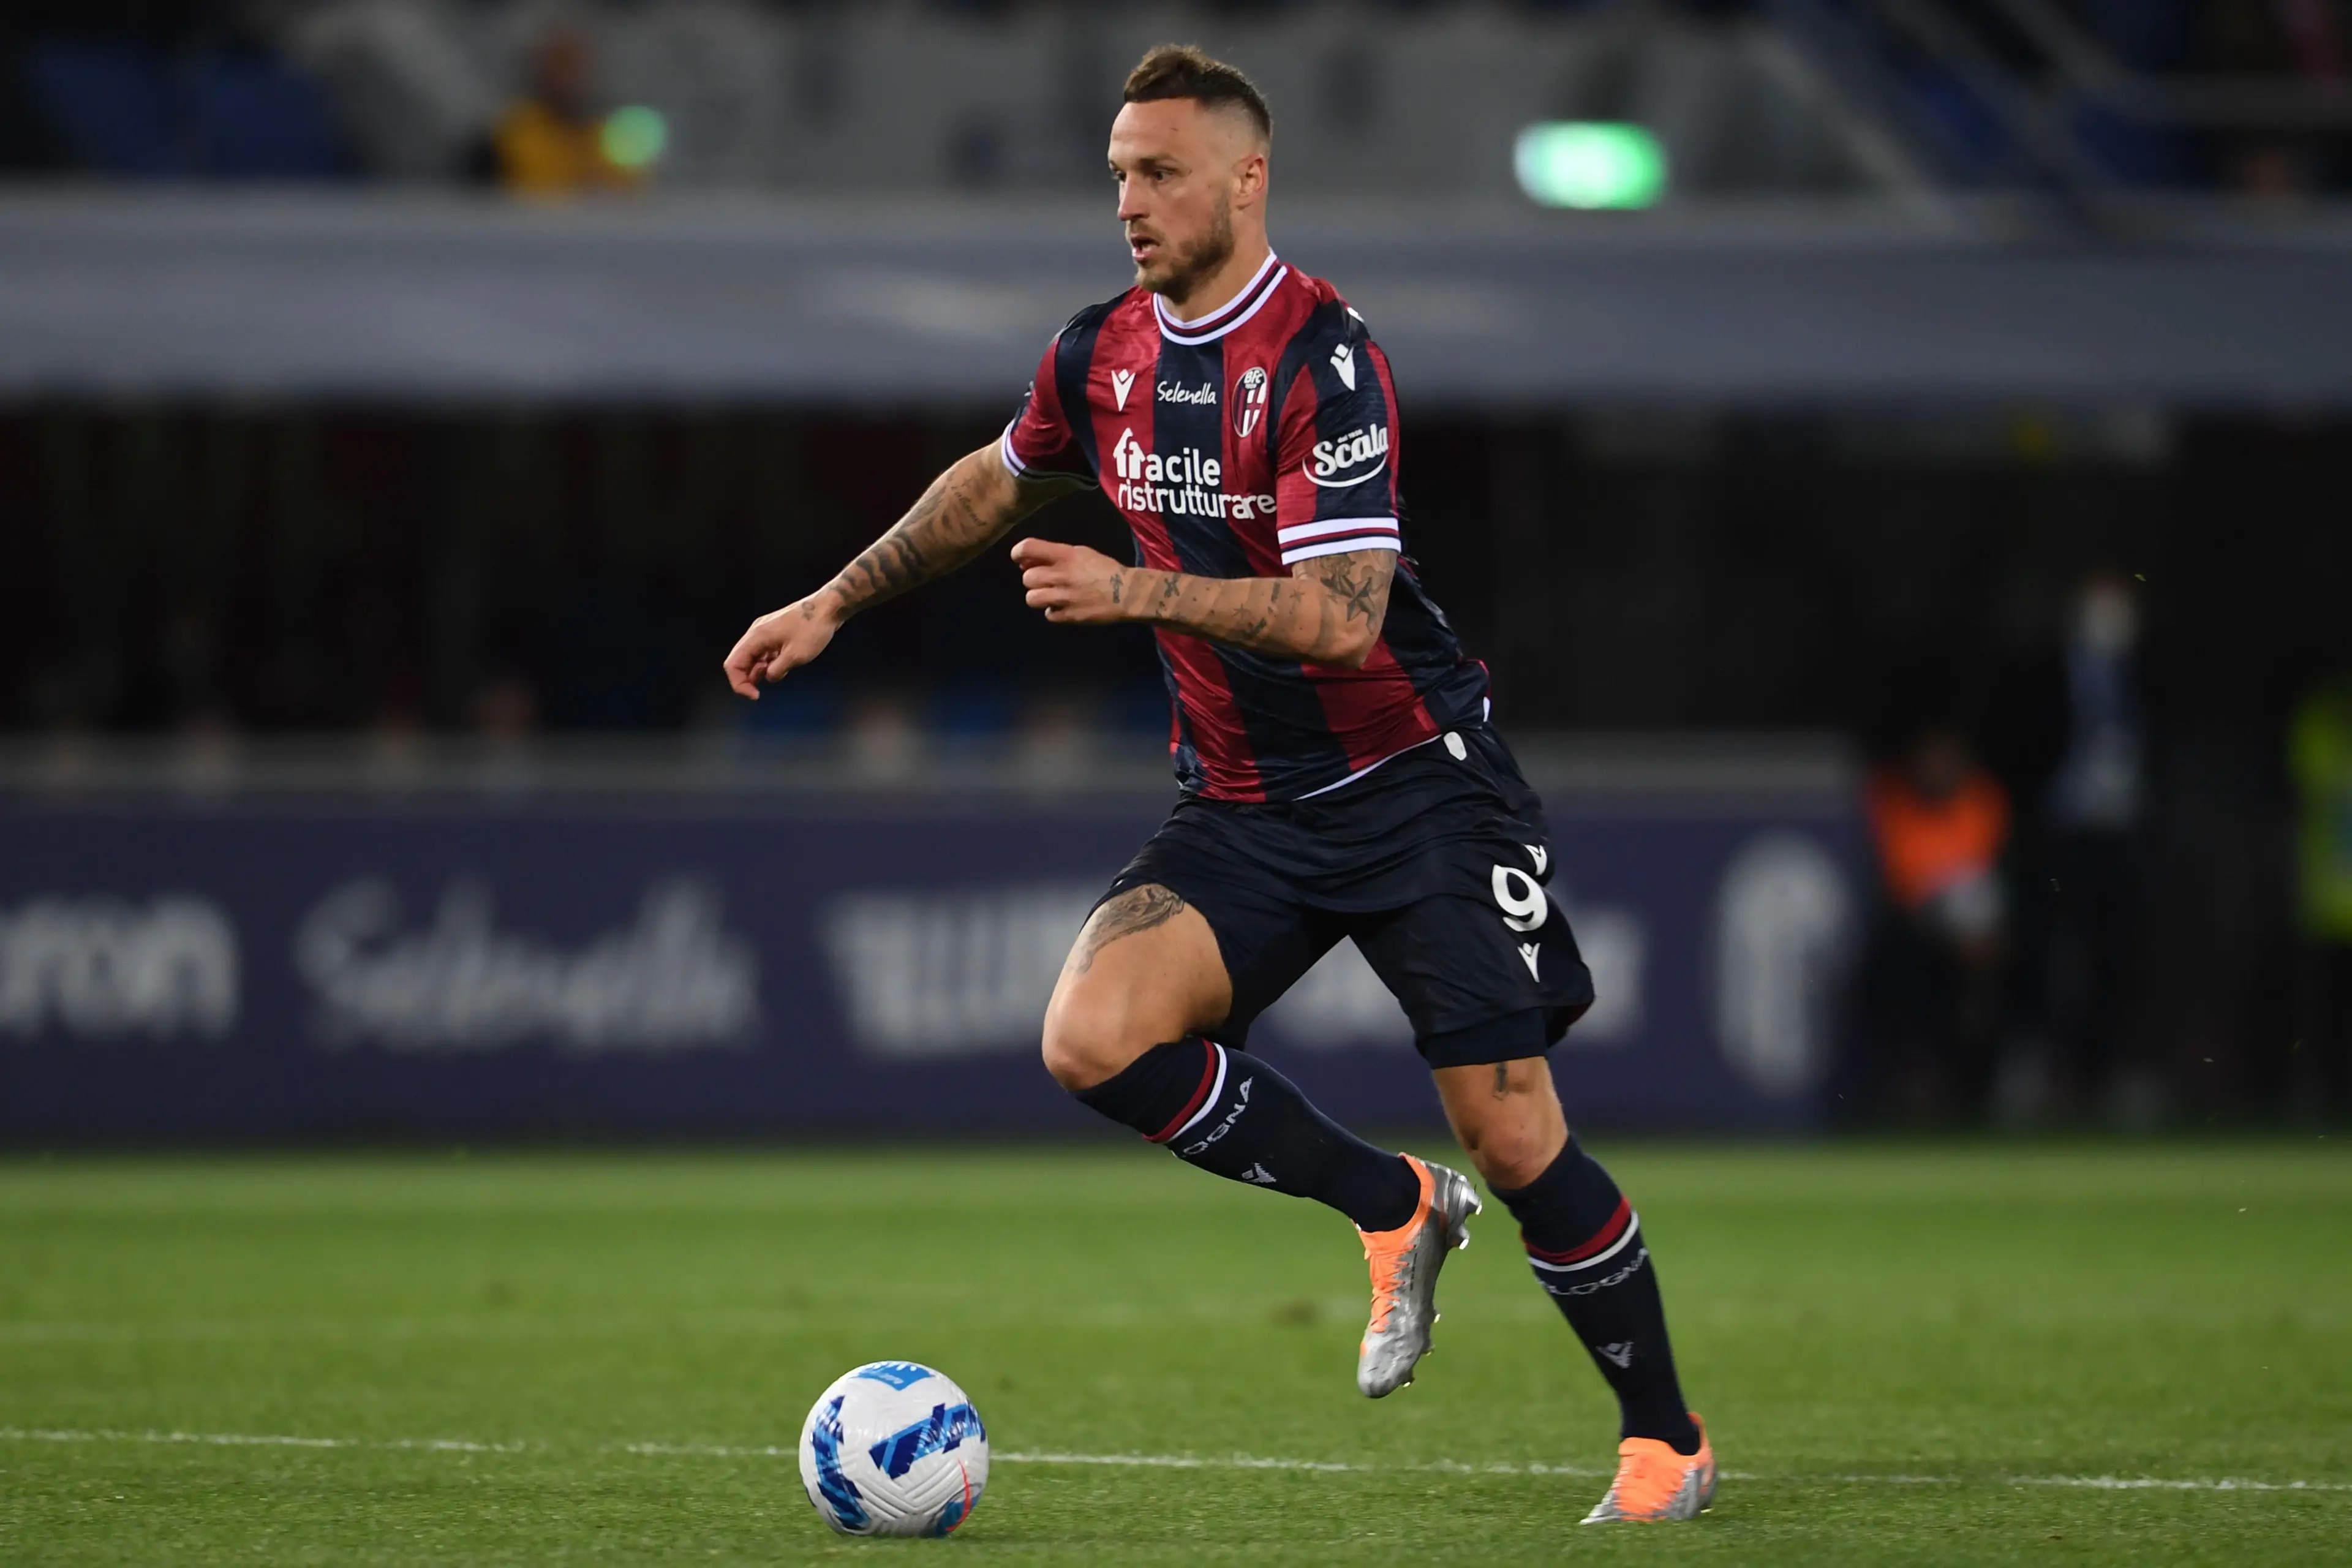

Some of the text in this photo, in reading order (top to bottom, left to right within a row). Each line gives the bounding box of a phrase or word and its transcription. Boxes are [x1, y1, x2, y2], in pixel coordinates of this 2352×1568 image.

[1157, 374, 1217, 405] Selenella
[1113, 428, 1221, 486] facile
[1312, 423, 1389, 477] Scala
[1117, 478, 1277, 519] ristrutturare
[1491, 864, 1548, 932] 9
[1182, 1076, 1254, 1158] OGNA
